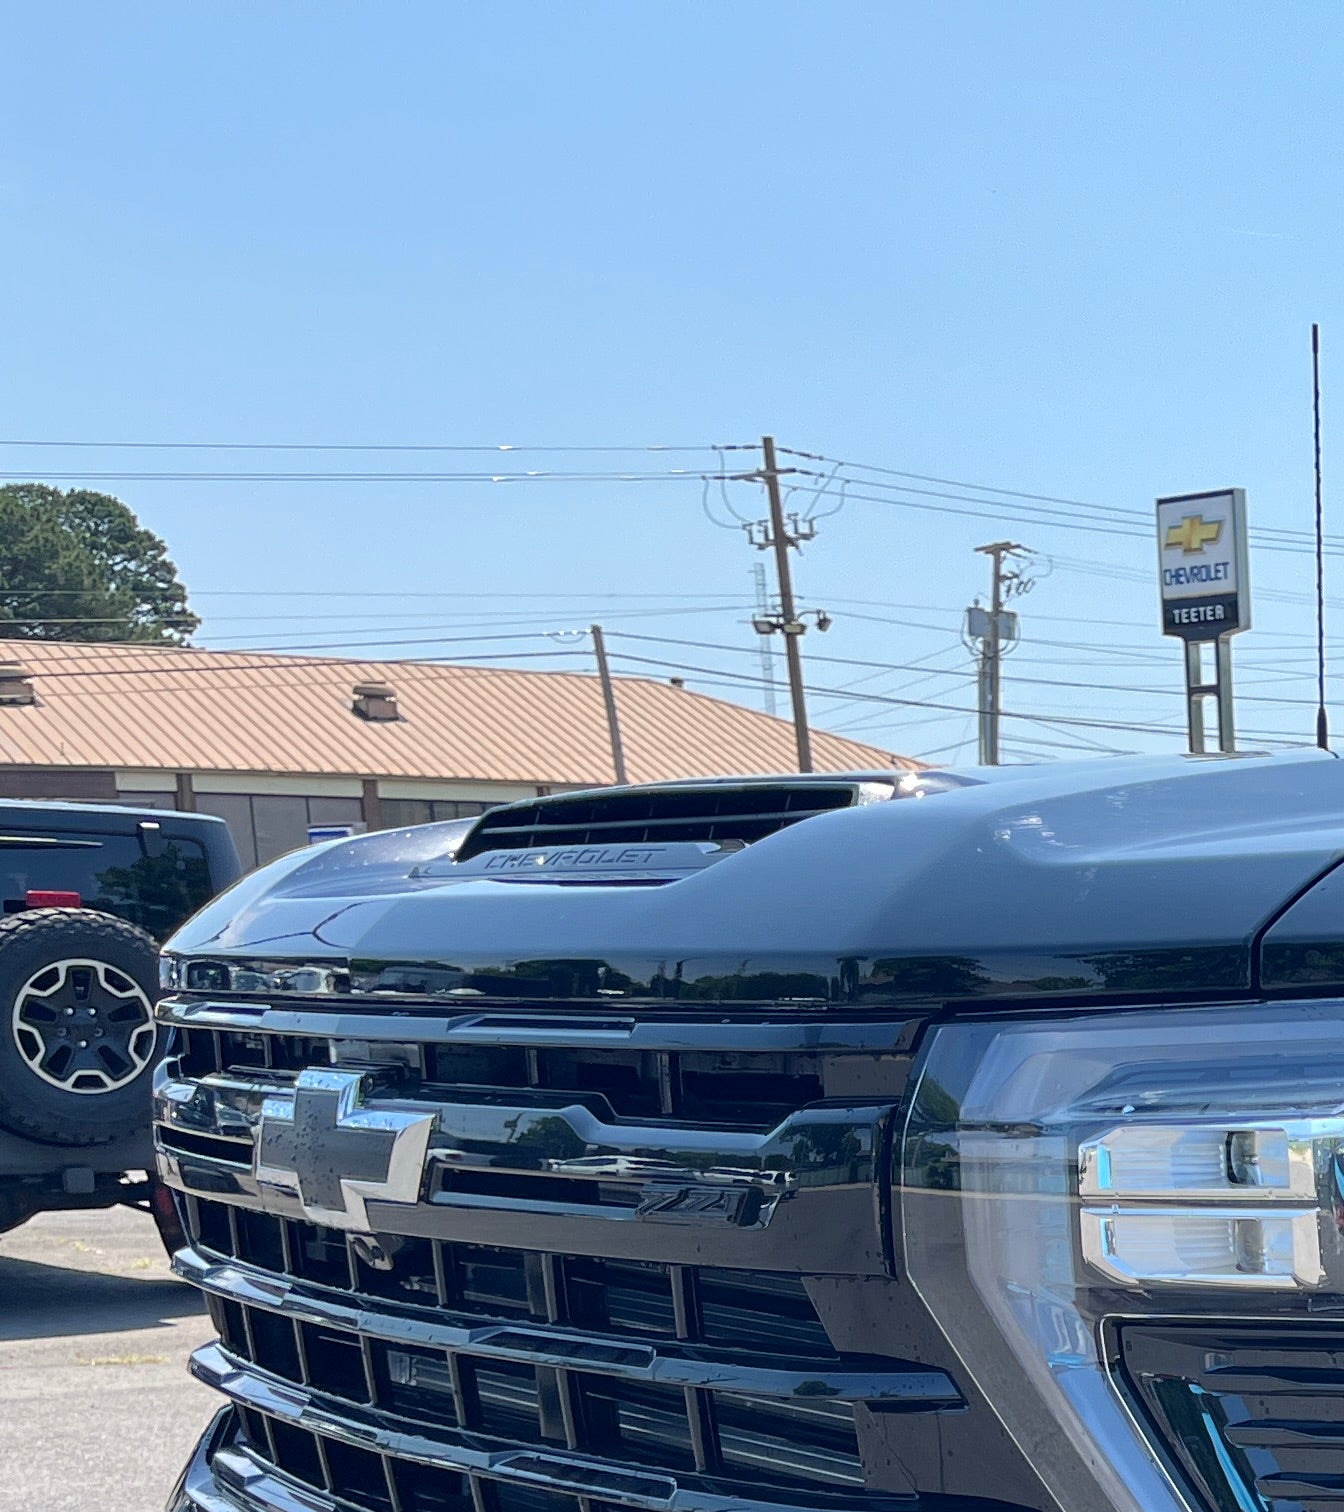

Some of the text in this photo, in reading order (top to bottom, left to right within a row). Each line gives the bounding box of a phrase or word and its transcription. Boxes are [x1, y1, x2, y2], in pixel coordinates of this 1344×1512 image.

[1163, 561, 1230, 587] CHEVROLET
[1172, 603, 1225, 624] TEETER
[484, 846, 668, 871] CHEVROLET
